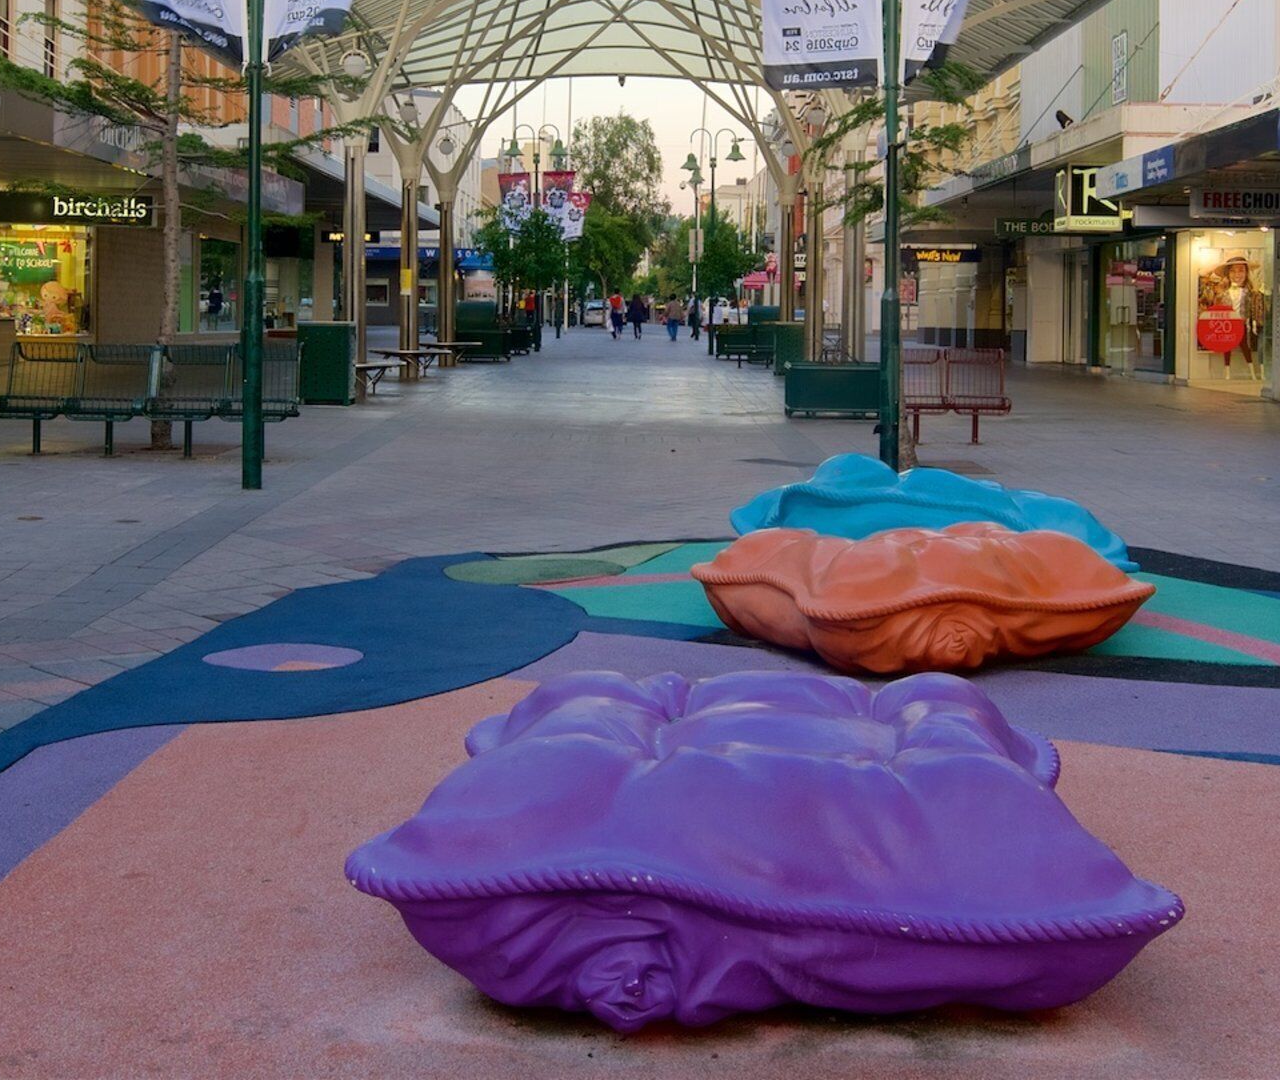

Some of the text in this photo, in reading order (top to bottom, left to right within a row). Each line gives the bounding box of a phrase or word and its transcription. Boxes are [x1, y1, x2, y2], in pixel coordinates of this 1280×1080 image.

[53, 195, 148, 220] birchalls
[1004, 221, 1027, 232] THE
[1031, 221, 1055, 232] BOD
